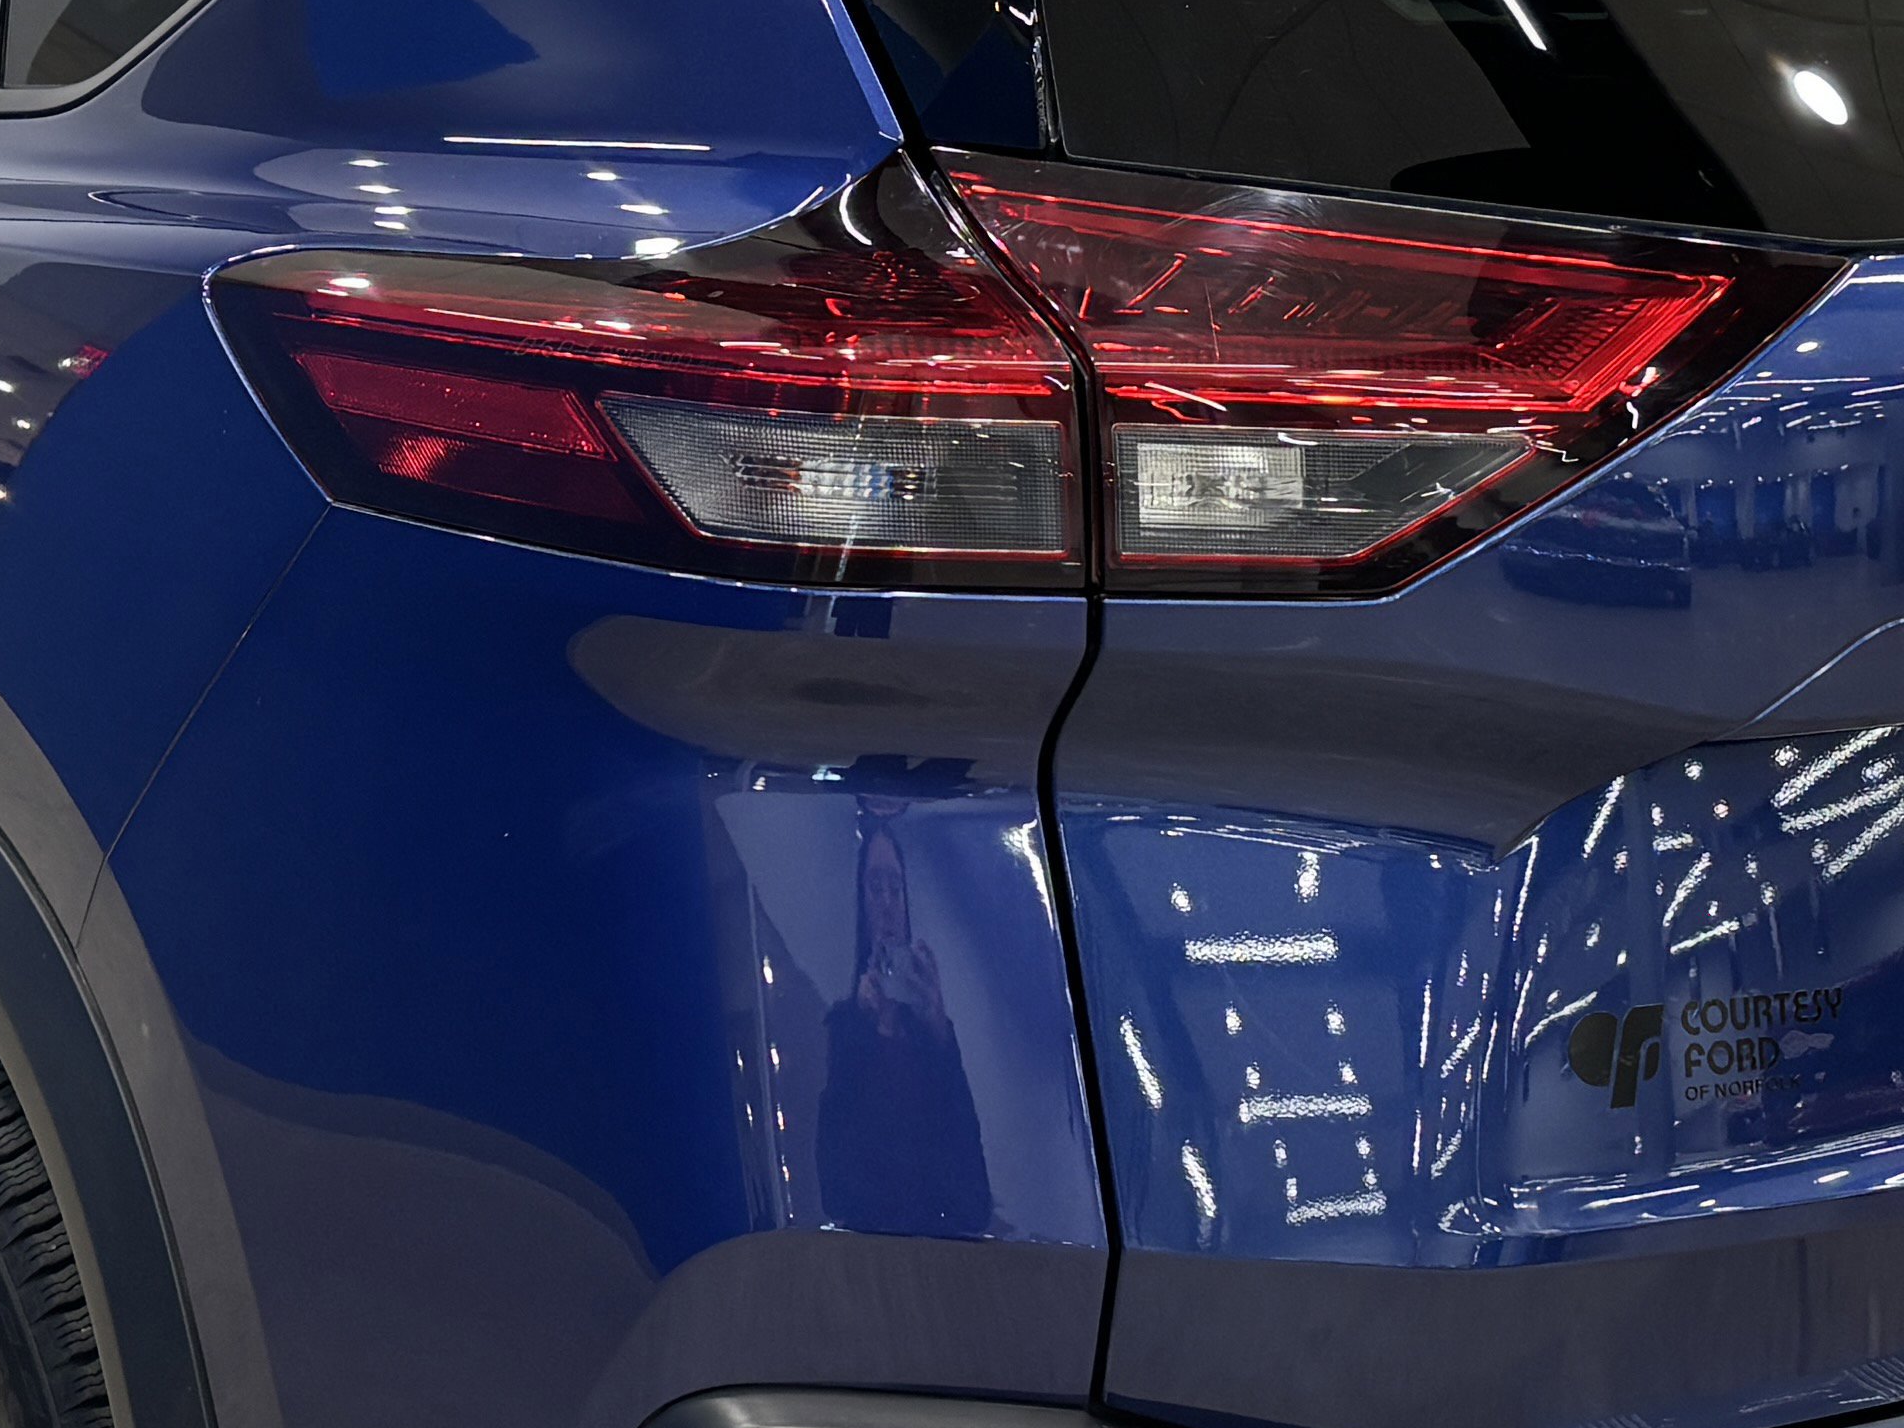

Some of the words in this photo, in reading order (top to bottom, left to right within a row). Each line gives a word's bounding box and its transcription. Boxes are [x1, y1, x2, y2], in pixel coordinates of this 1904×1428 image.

[1680, 986, 1844, 1036] COURTESY
[1685, 1036, 1781, 1078] FORD
[1684, 1085, 1710, 1102] OF
[1714, 1075, 1800, 1100] NORFOLK
